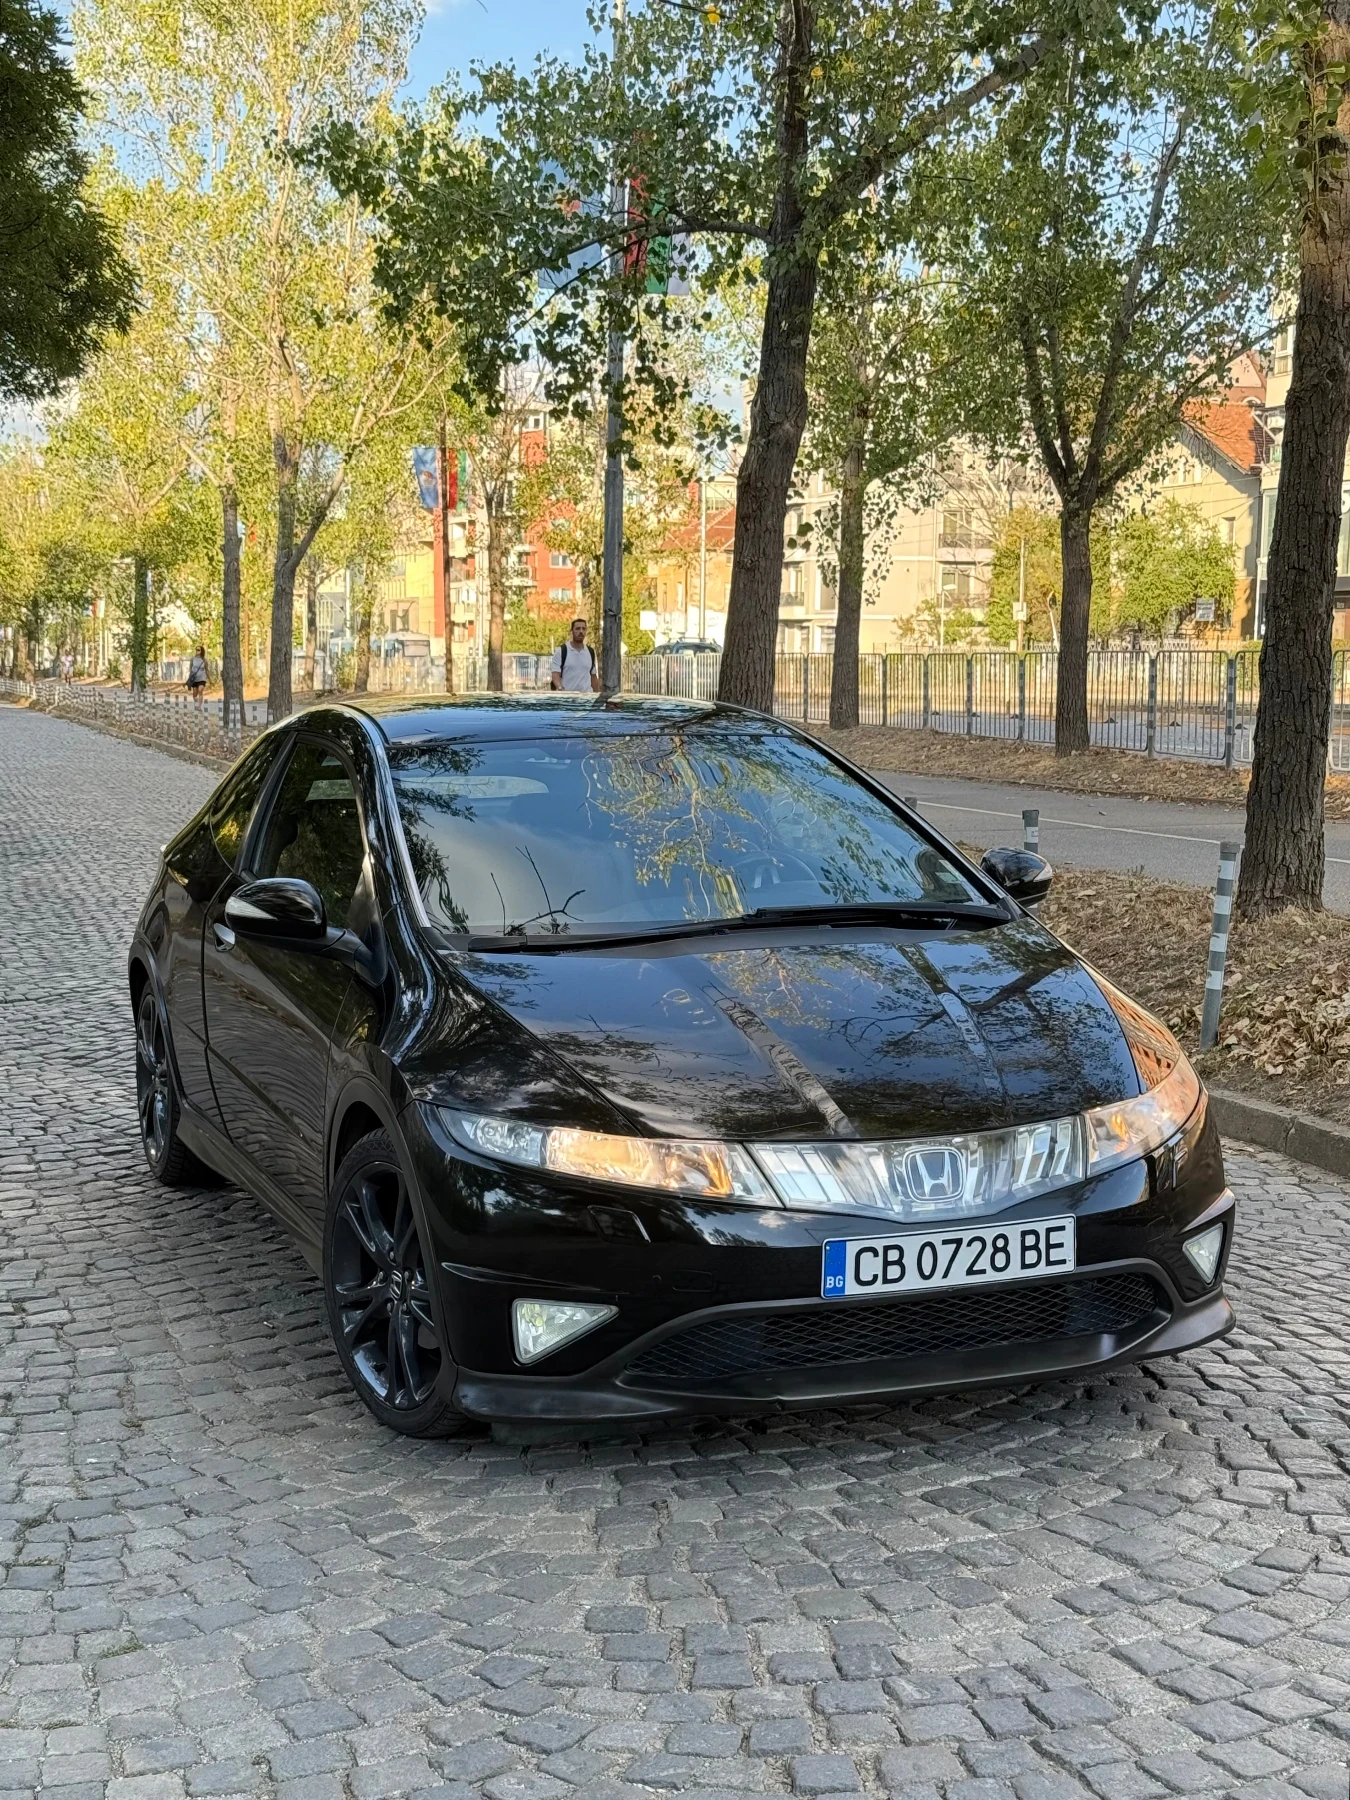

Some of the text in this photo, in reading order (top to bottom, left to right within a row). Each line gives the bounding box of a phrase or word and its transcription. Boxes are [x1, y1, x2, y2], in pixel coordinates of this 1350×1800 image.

[854, 1225, 1068, 1287] CB 0728 BE
[826, 1275, 844, 1288] BG
